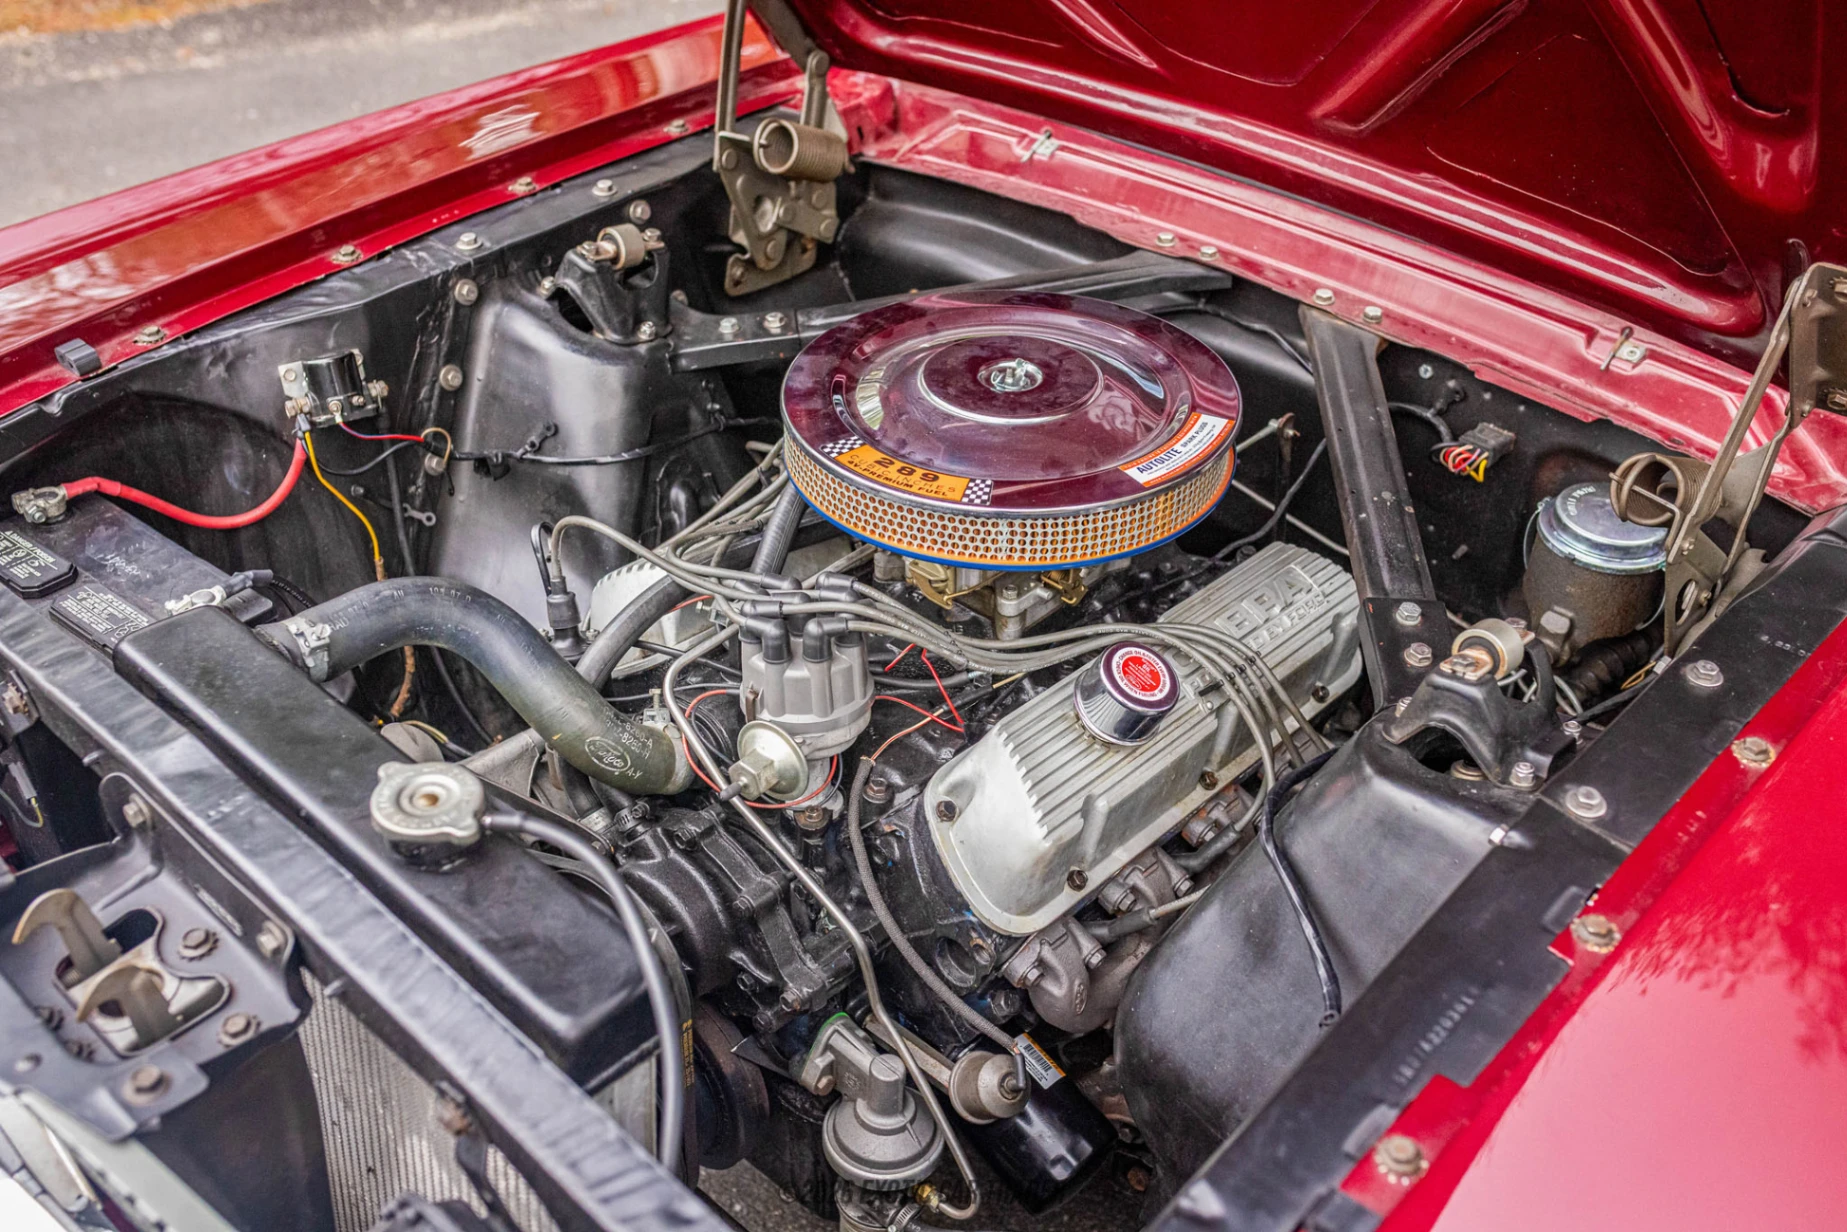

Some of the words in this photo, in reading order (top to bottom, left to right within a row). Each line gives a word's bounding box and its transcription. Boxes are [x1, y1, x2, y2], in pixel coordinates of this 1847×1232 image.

[874, 457, 940, 483] 289
[1136, 447, 1182, 474] AUTOLITE
[1180, 436, 1196, 449] SPARK
[850, 454, 891, 477] CUBIC
[896, 475, 956, 494] INCHES
[917, 486, 949, 497] FUEL
